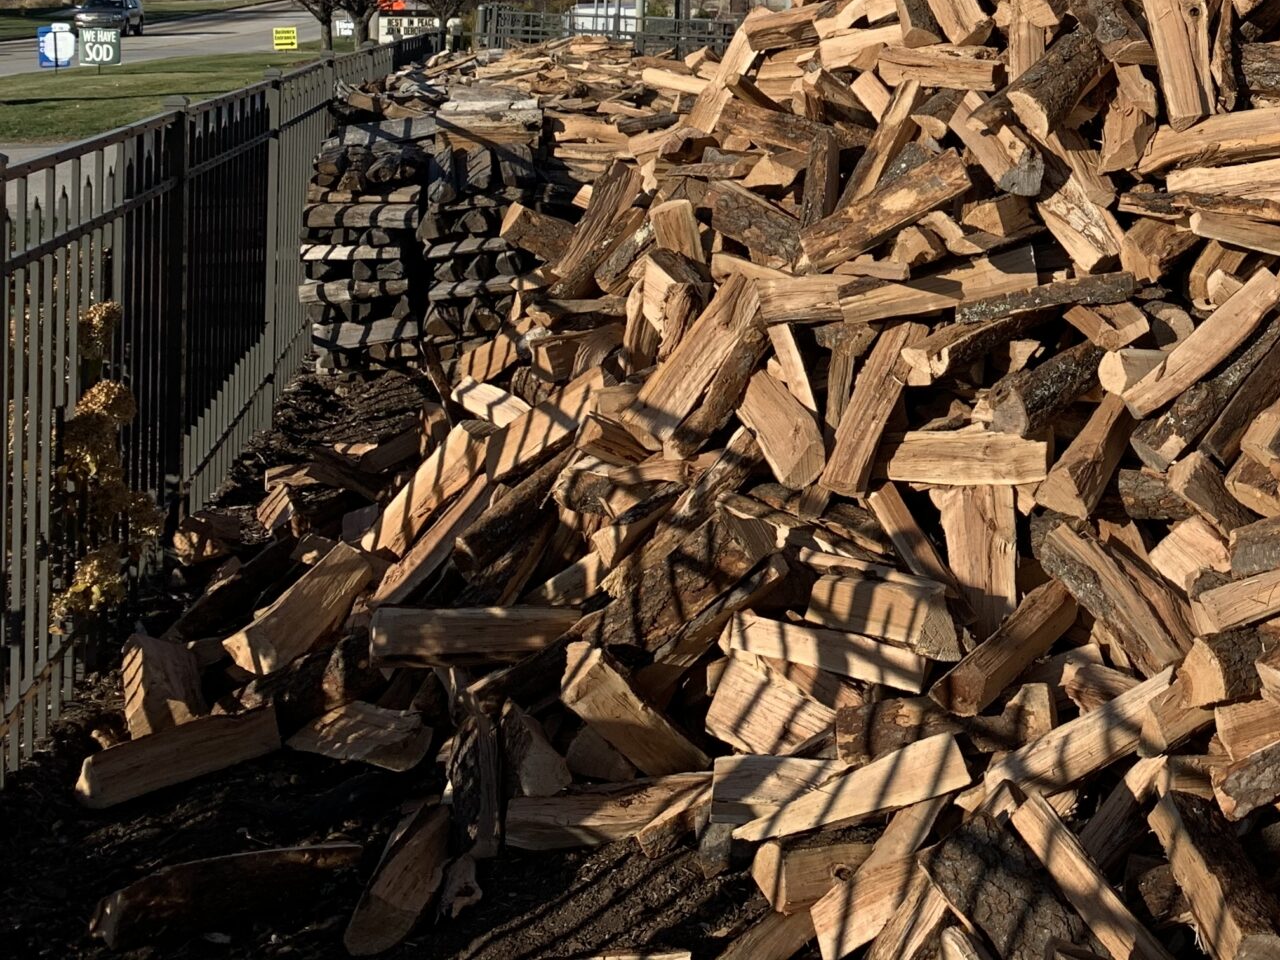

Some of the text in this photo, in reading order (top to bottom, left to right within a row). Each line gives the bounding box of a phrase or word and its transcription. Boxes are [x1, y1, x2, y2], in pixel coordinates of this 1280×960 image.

[82, 29, 117, 42] WE HAVE
[84, 43, 114, 62] SOD
